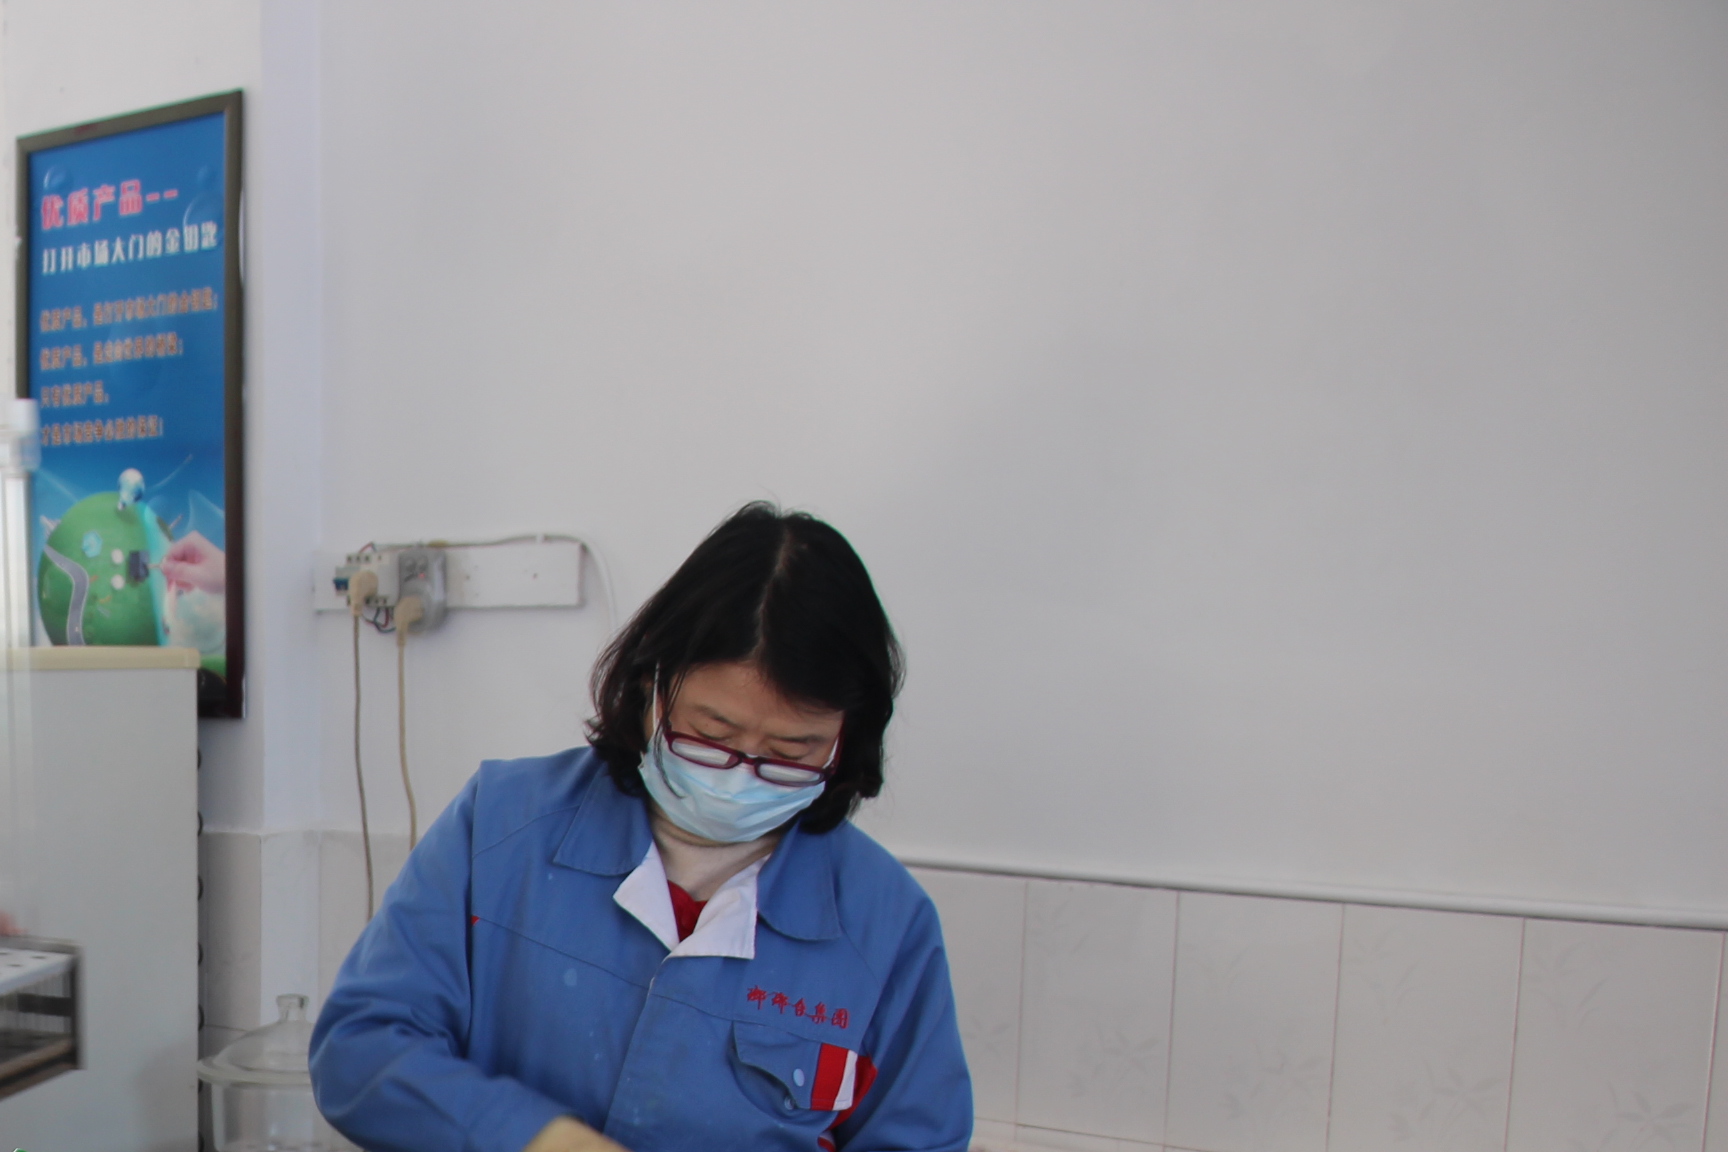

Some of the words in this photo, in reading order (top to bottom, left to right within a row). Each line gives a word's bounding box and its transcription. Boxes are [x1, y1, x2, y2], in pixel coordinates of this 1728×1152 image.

[41, 220, 218, 274] 打开市场大门的金钥匙
